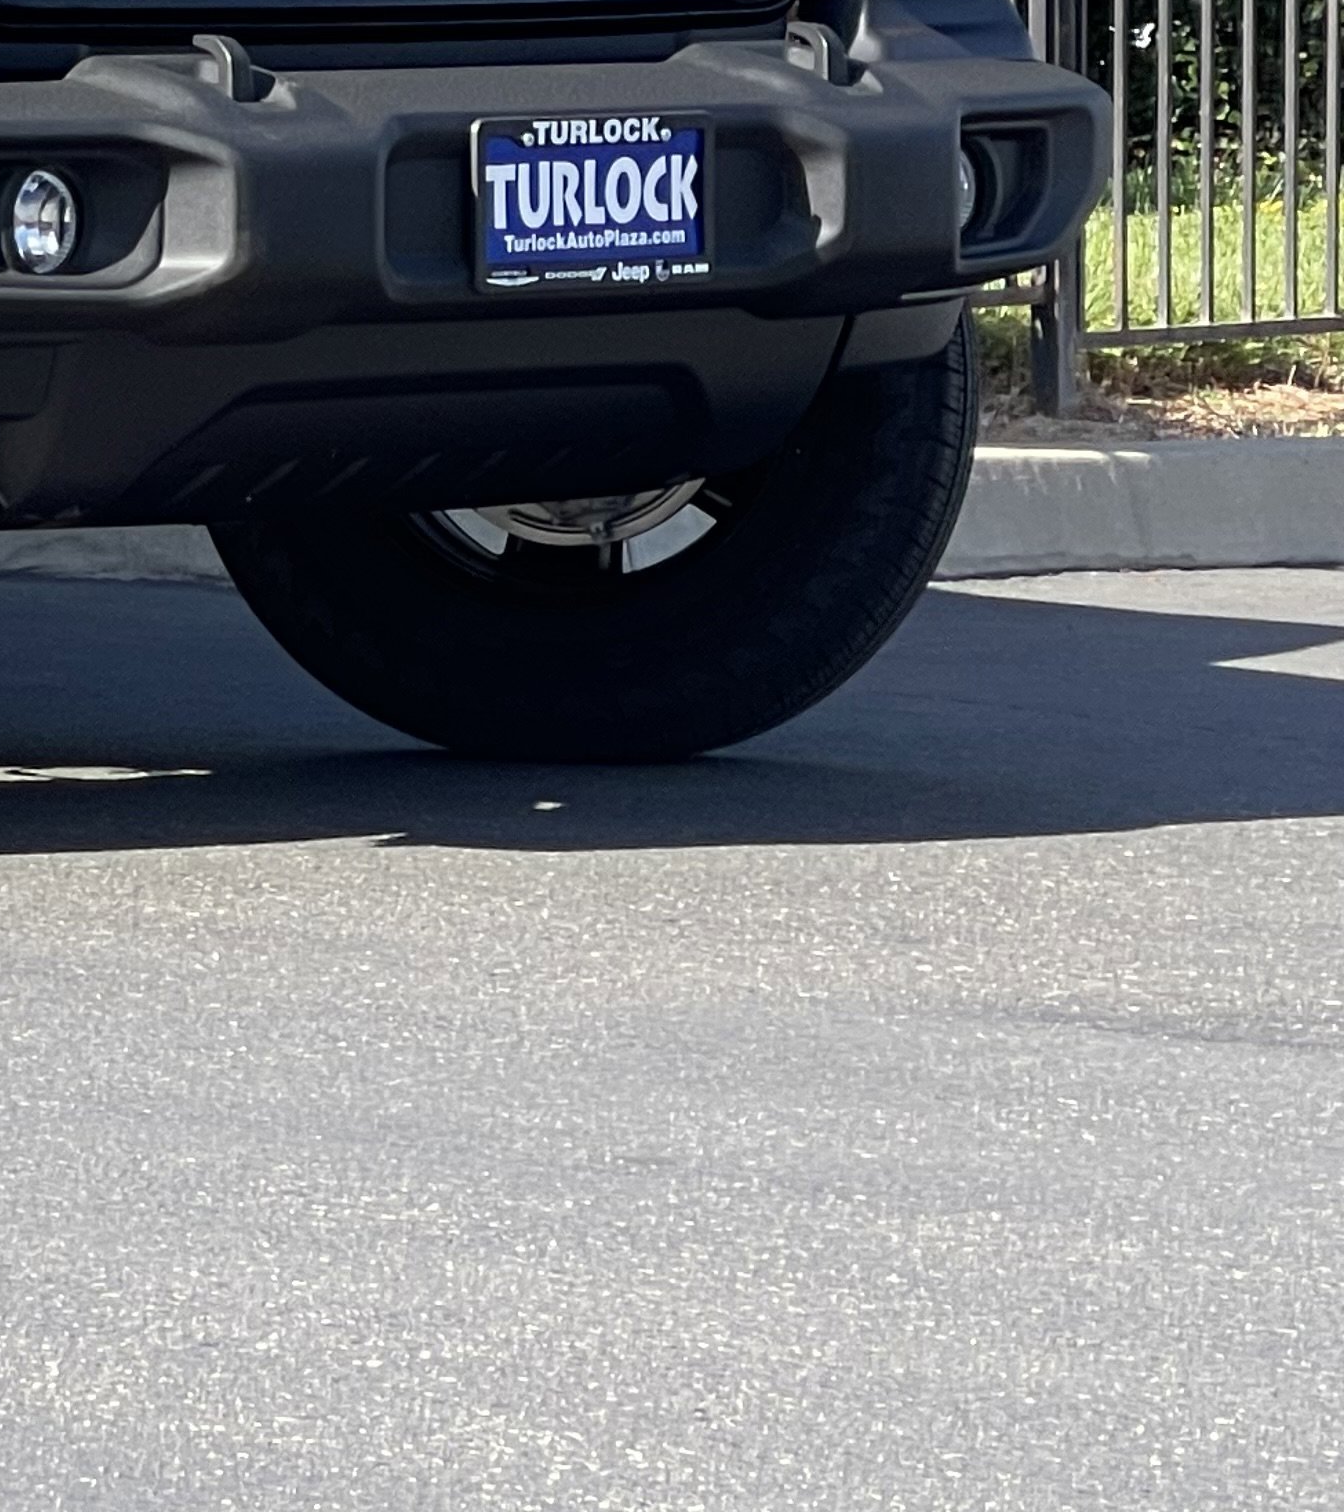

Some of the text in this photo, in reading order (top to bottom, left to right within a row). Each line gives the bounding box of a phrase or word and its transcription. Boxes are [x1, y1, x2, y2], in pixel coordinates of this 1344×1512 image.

[533, 117, 660, 146] TURLOCK
[485, 154, 698, 230] TURLOCK
[504, 229, 686, 254] TurlockAutoPlaza.com
[612, 262, 650, 283] Jeep
[672, 263, 710, 275] RAM
